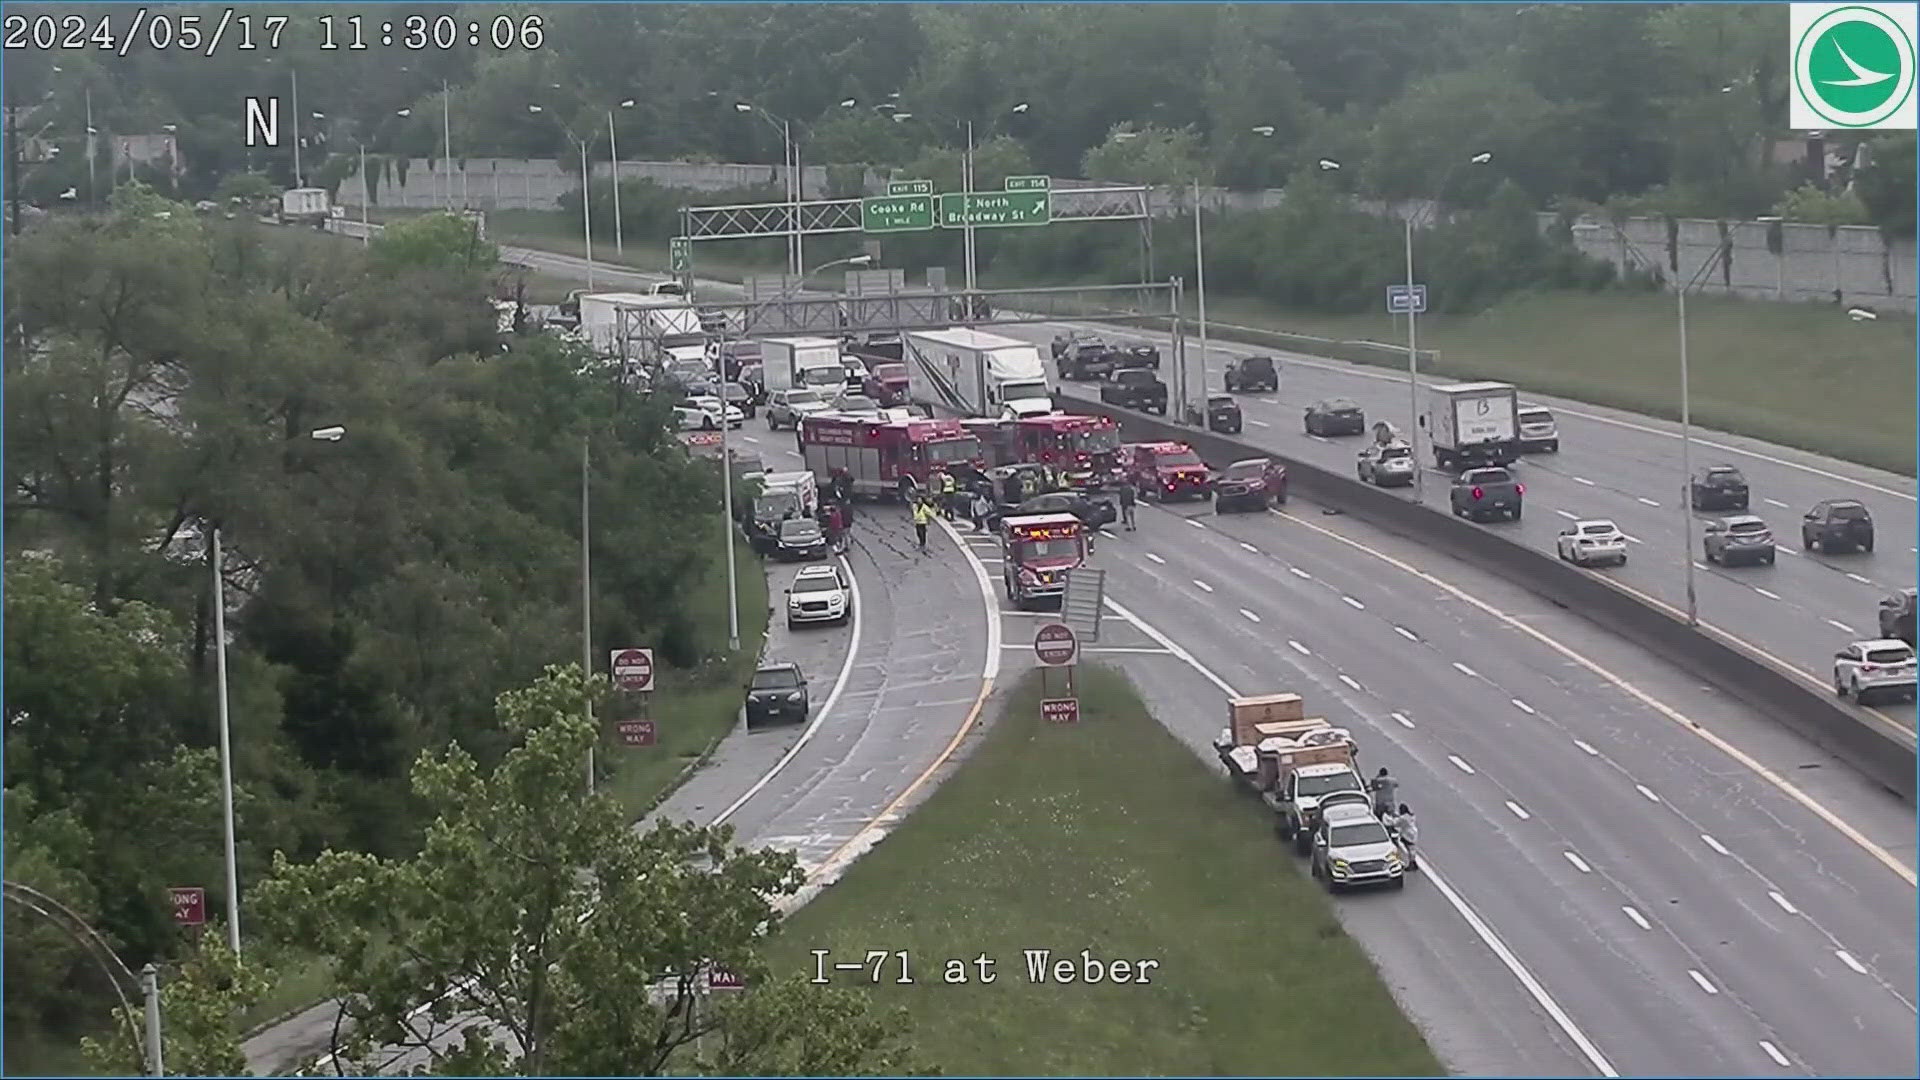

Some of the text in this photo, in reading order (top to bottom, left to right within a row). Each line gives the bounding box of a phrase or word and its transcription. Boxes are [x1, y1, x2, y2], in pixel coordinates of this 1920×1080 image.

[892, 184, 928, 193] EXIT 115
[1009, 179, 1045, 188] EXIT 114
[870, 202, 925, 214] Cooke Rd
[976, 197, 1009, 209] North
[1011, 209, 1025, 220] St
[894, 217, 911, 225] MILE
[1040, 632, 1069, 641] DO NOT
[631, 657, 646, 665] NOT
[1043, 702, 1076, 713] WRONG
[1050, 713, 1070, 722] WAY
[619, 724, 651, 734] WRONG
[625, 734, 645, 744] WAY
[172, 893, 198, 905] ONG
